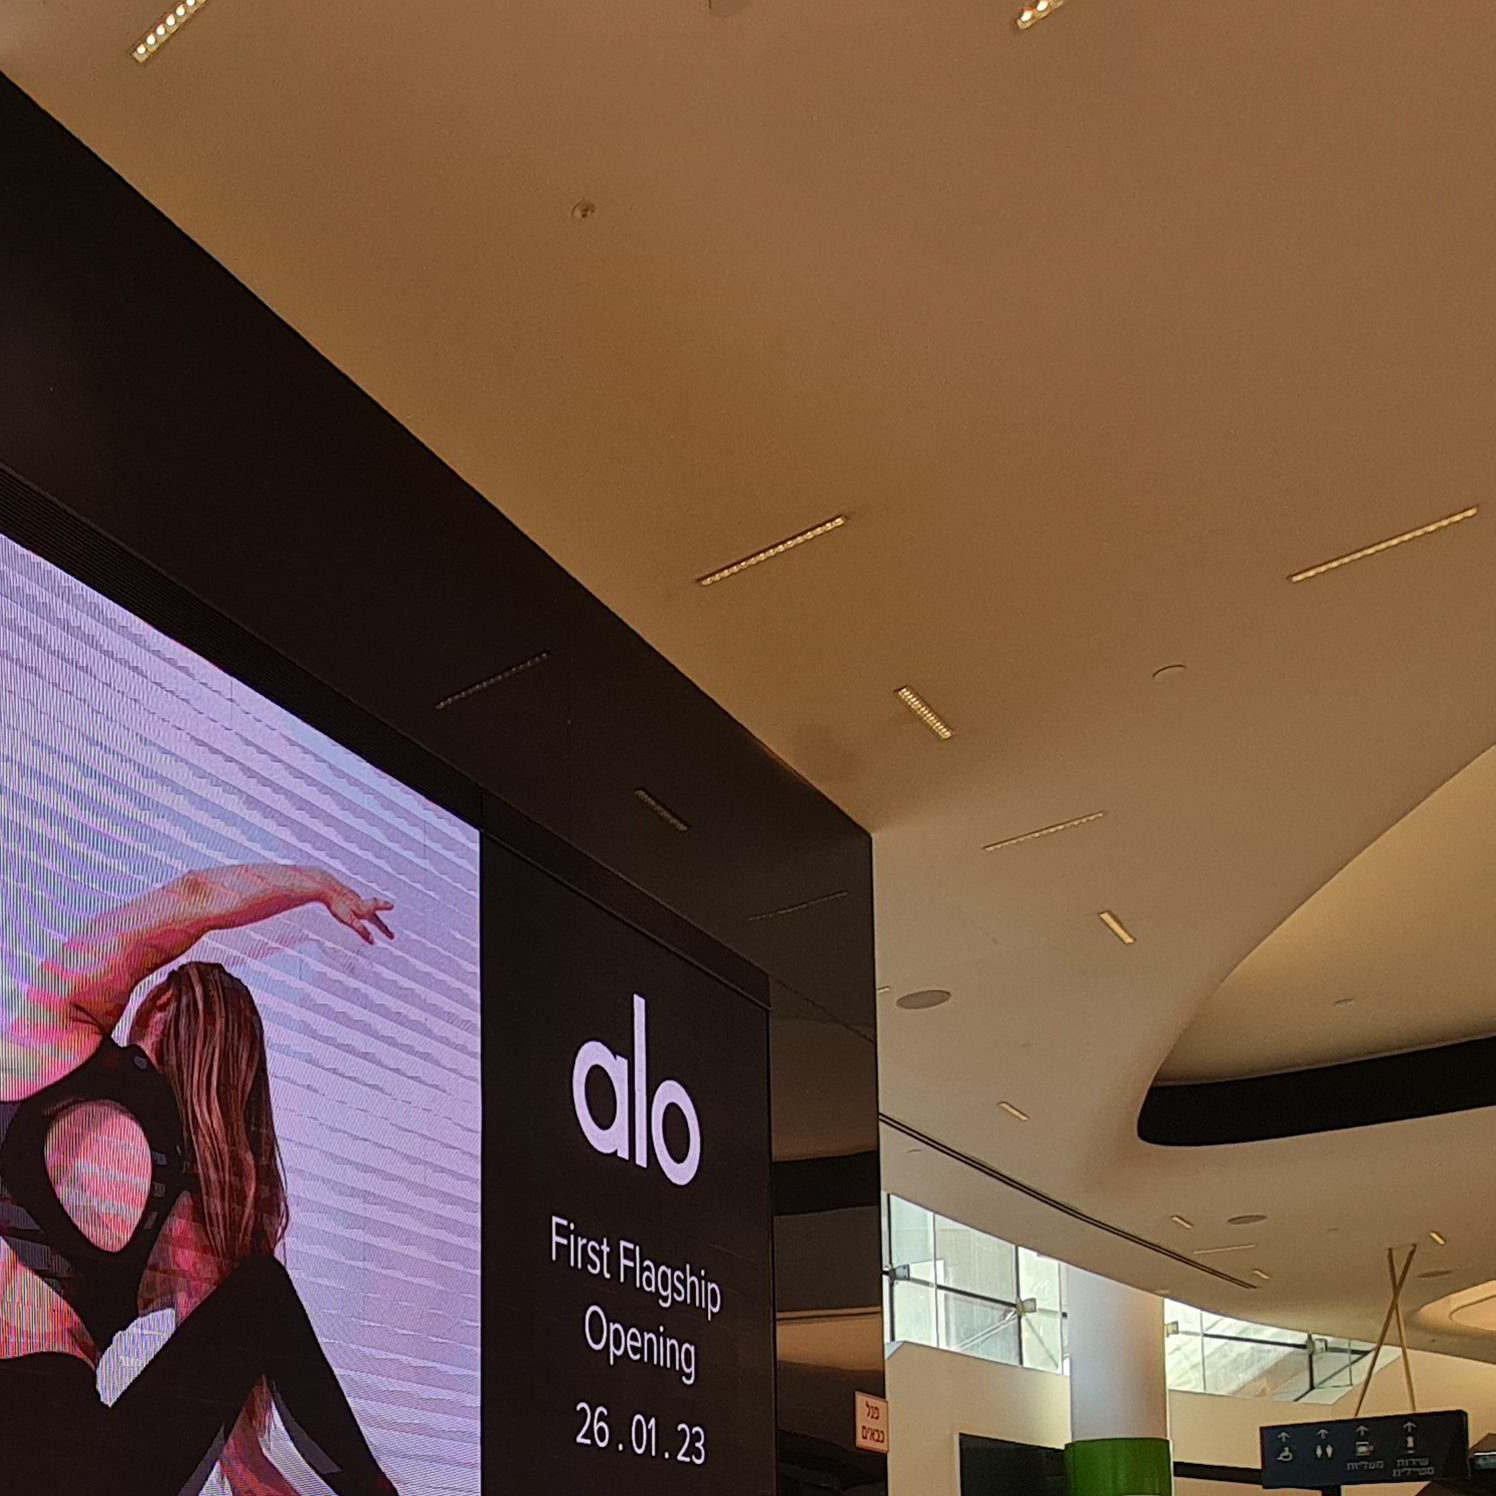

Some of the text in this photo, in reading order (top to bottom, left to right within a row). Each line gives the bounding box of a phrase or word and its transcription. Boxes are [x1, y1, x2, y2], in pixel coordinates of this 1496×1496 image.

[572, 993, 701, 1186] alo
[551, 1215, 721, 1321] First Flagship
[584, 1305, 695, 1385] Opening
